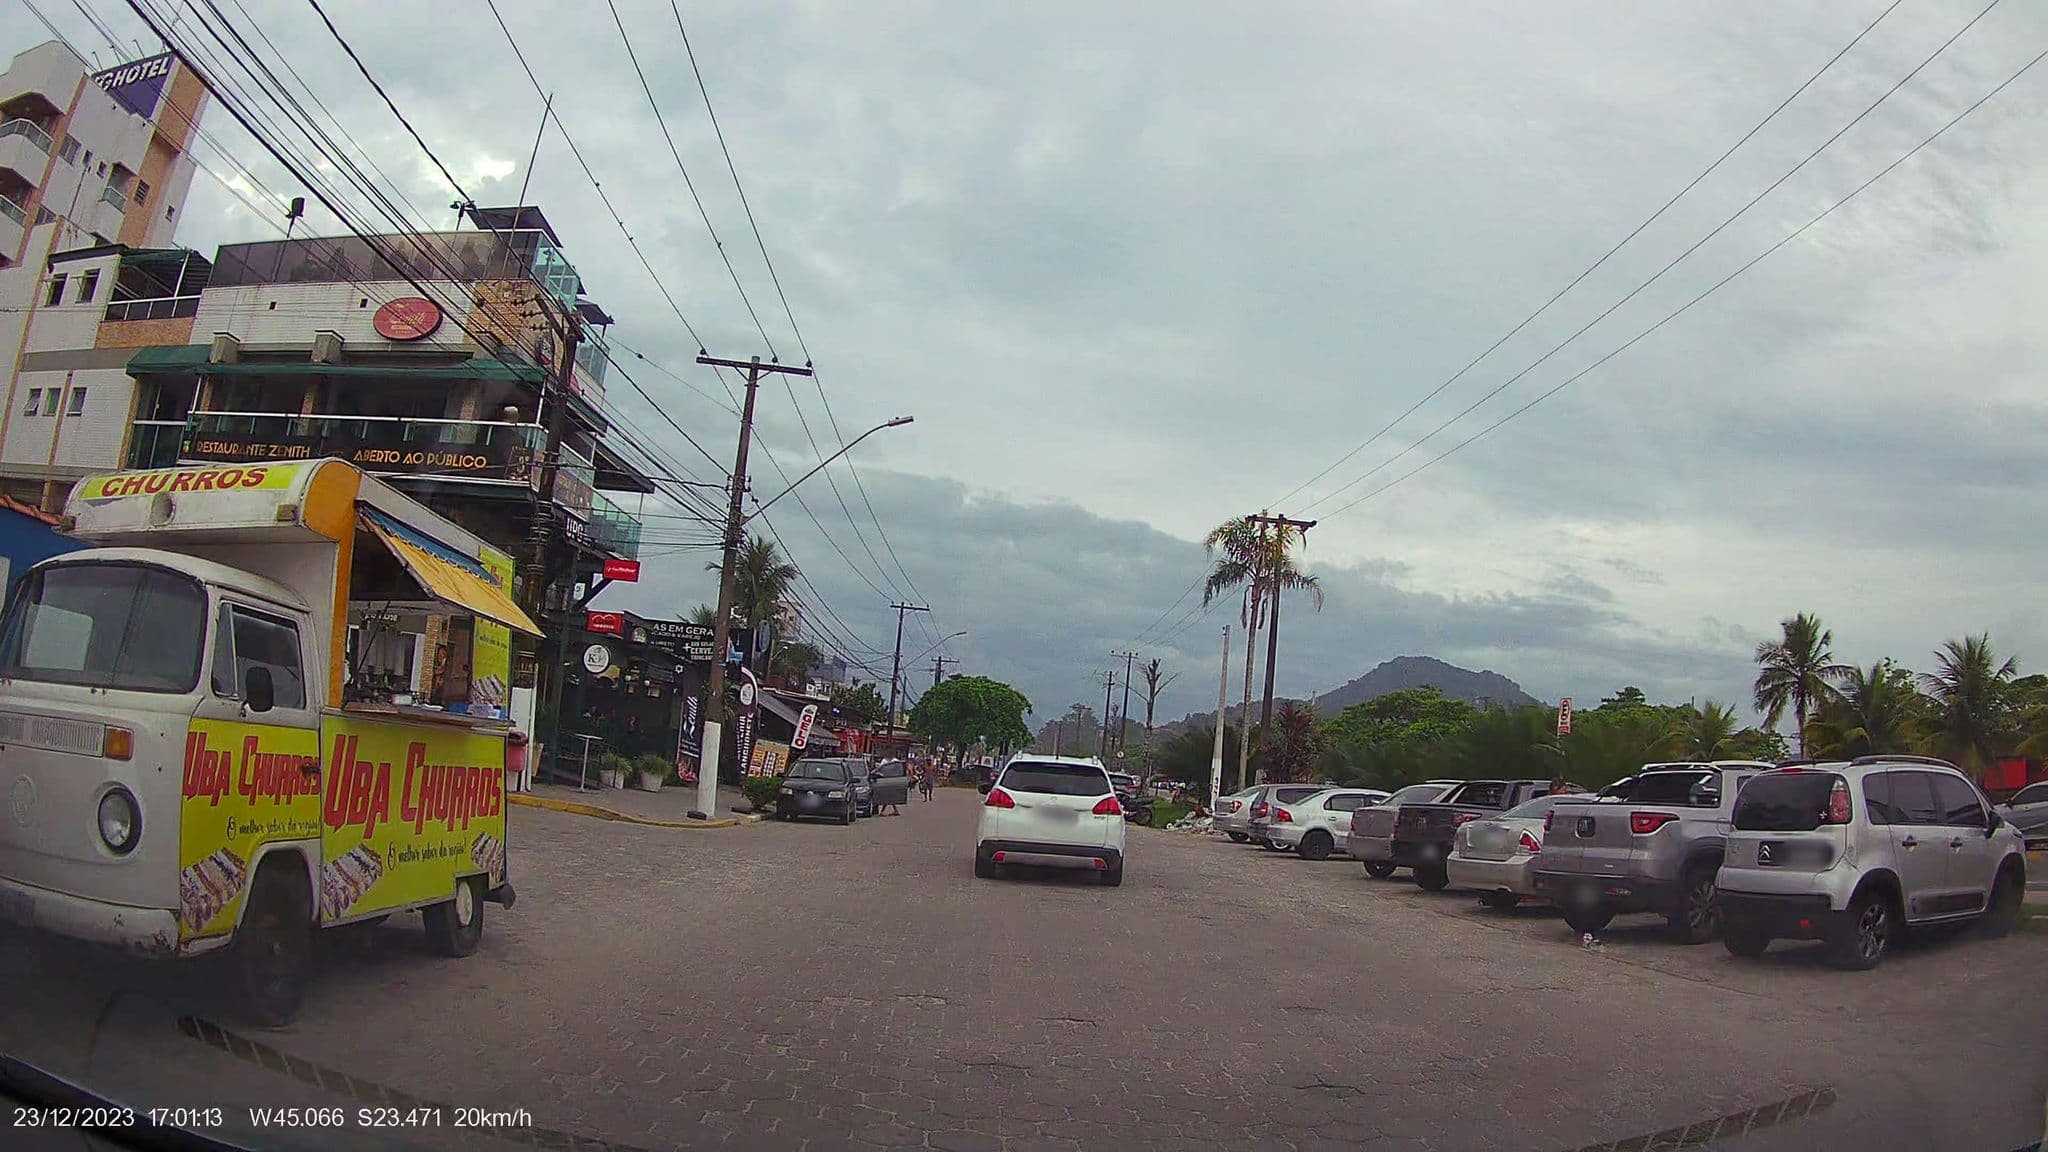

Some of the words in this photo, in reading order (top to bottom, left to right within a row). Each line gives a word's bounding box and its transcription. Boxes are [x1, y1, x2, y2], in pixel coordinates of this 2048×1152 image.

[112, 57, 169, 87] HOTEL
[197, 440, 266, 456] RESTAURANTE
[268, 444, 311, 458] ZENITH
[353, 449, 400, 464] ABERTO
[403, 452, 424, 464] AO
[426, 450, 487, 468] PÚBLICO
[102, 467, 268, 497] CHURROS
[685, 626, 714, 636] GERA
[795, 714, 812, 747] GELO
